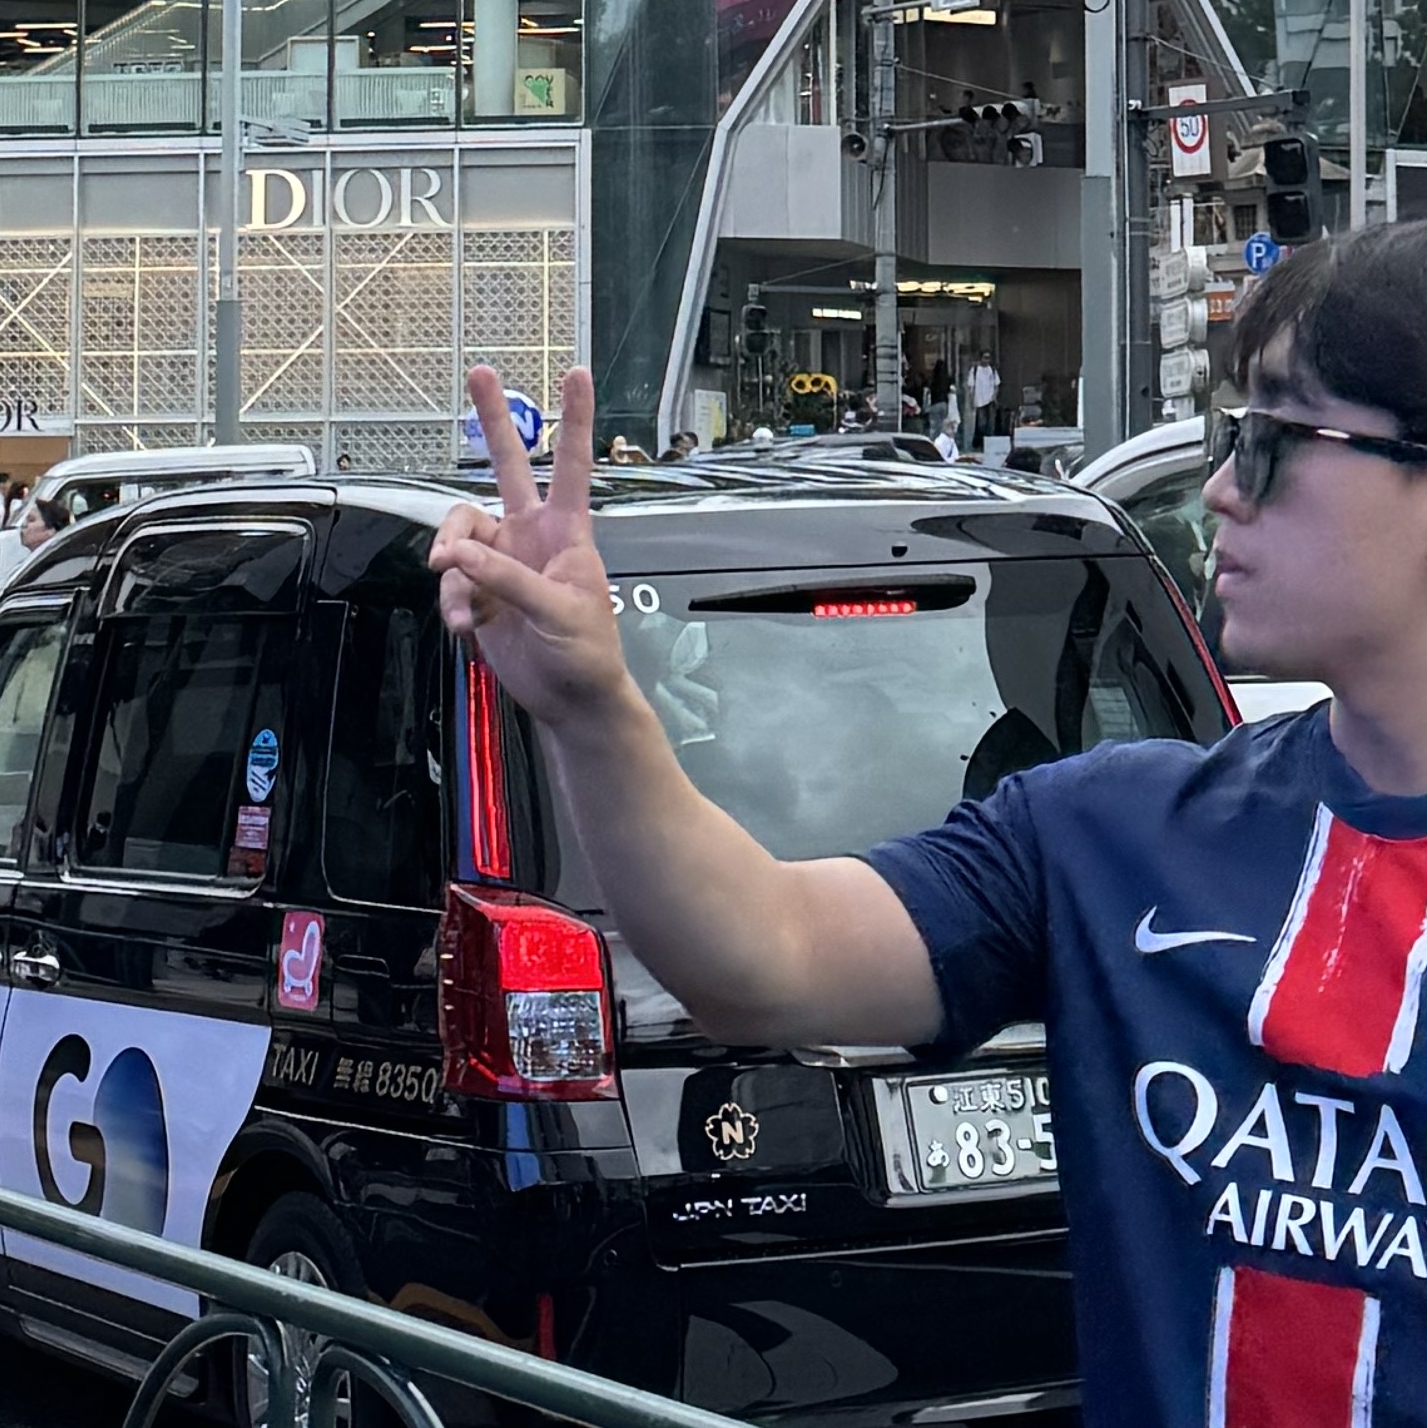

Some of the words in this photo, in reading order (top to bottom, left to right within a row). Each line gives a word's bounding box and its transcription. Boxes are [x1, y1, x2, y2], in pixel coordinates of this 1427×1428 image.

[244, 168, 456, 231] DIOR
[272, 1043, 320, 1086] TAXI
[33, 1033, 170, 1238] GO
[721, 1120, 744, 1145] N
[740, 1192, 807, 1217] TAXI
